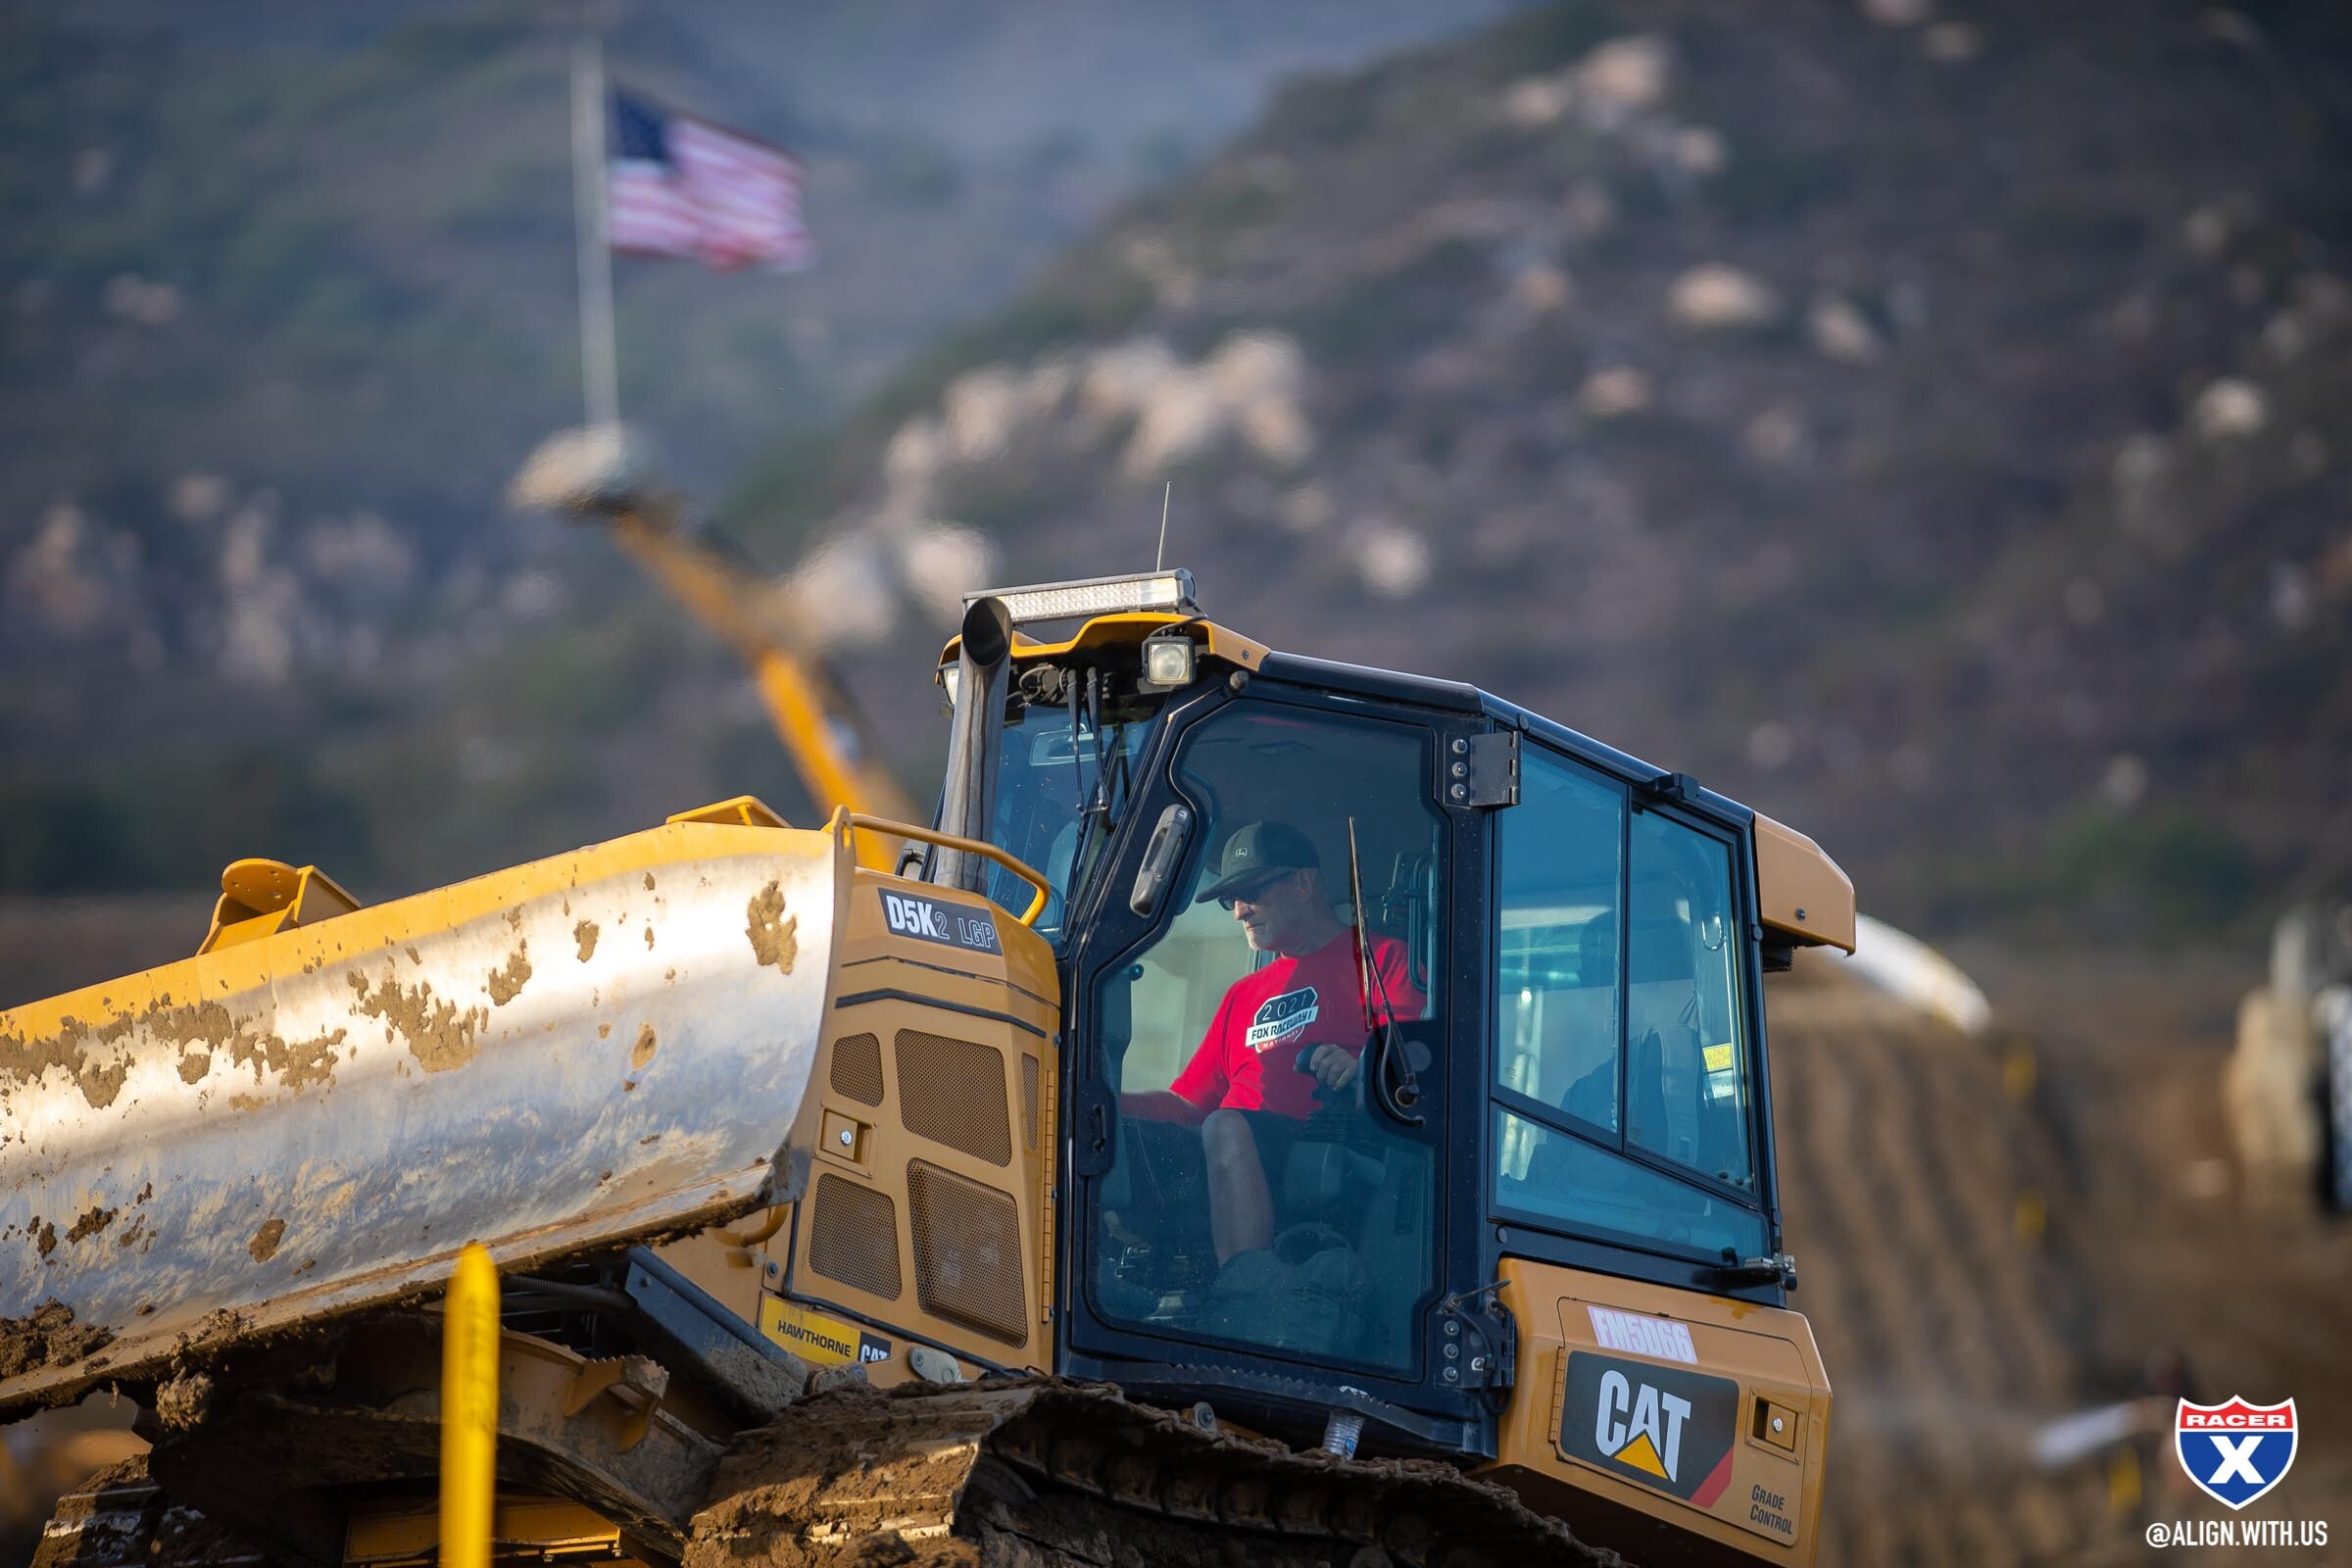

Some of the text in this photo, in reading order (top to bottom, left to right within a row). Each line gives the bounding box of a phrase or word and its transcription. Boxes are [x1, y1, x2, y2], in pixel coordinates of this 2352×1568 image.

[957, 917, 994, 948] LGP
[1262, 994, 1307, 1021] 2021
[1251, 1026, 1269, 1040] FOX
[777, 1319, 852, 1357] HAWTHORNE
[1592, 1308, 1695, 1362] FM5D66
[1595, 1370, 1691, 1483] CAT
